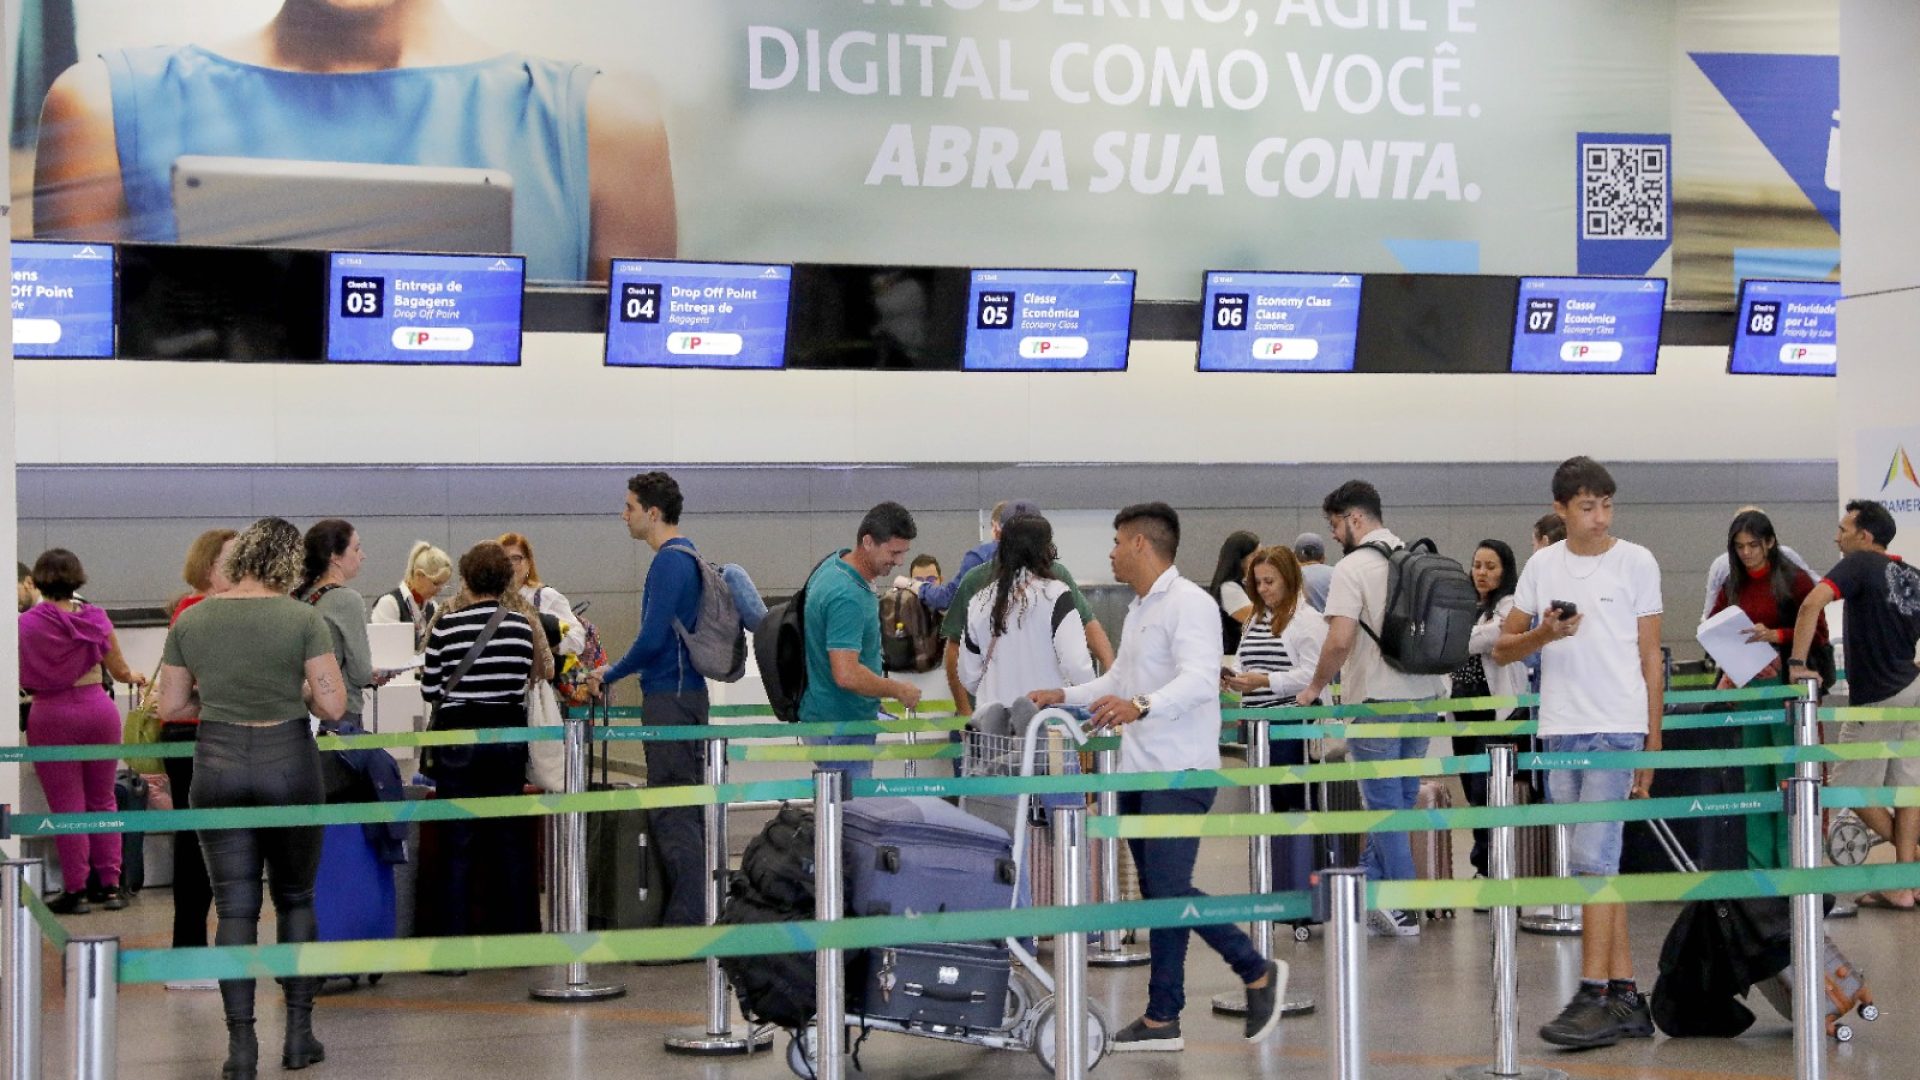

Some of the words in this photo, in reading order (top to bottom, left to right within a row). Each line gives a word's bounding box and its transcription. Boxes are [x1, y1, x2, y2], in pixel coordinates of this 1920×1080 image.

[748, 25, 1030, 101] DIGITAL
[1049, 42, 1269, 110] COMO
[1286, 40, 1483, 119] VOCÊ.
[863, 124, 1070, 191] ABRA
[1088, 131, 1225, 195] SUA
[1245, 137, 1483, 202] CONTA.
[11, 271, 38, 282] ens
[36, 285, 74, 298] Point
[395, 280, 443, 294] Entrega
[446, 281, 463, 292] de
[671, 286, 701, 301] Drop
[703, 287, 724, 299] Off
[726, 288, 758, 300] Point
[347, 292, 377, 313] 03
[394, 295, 456, 309] Bagagens
[1023, 292, 1057, 305] Classe
[1257, 295, 1303, 309] Economy
[1306, 295, 1332, 307] Class
[1566, 299, 1597, 311] Classe
[393, 310, 417, 320] Drop
[419, 309, 434, 320] Off
[436, 310, 460, 319] Point
[627, 298, 655, 318] 04
[670, 301, 715, 315] Entrega
[718, 302, 733, 314] de
[982, 305, 1008, 325] 05
[1022, 307, 1080, 319] Econômica
[1255, 309, 1288, 320] Classe
[1787, 303, 1836, 315] Prioridade
[668, 314, 710, 325] Bagagens
[1217, 307, 1242, 326] 06
[1529, 311, 1553, 330] 07
[1564, 313, 1617, 325] Econômica
[1751, 314, 1775, 333] 08
[1784, 318, 1802, 328] por
[1803, 316, 1818, 328] Lei
[1020, 320, 1057, 331] Economy
[1058, 320, 1079, 329] Class
